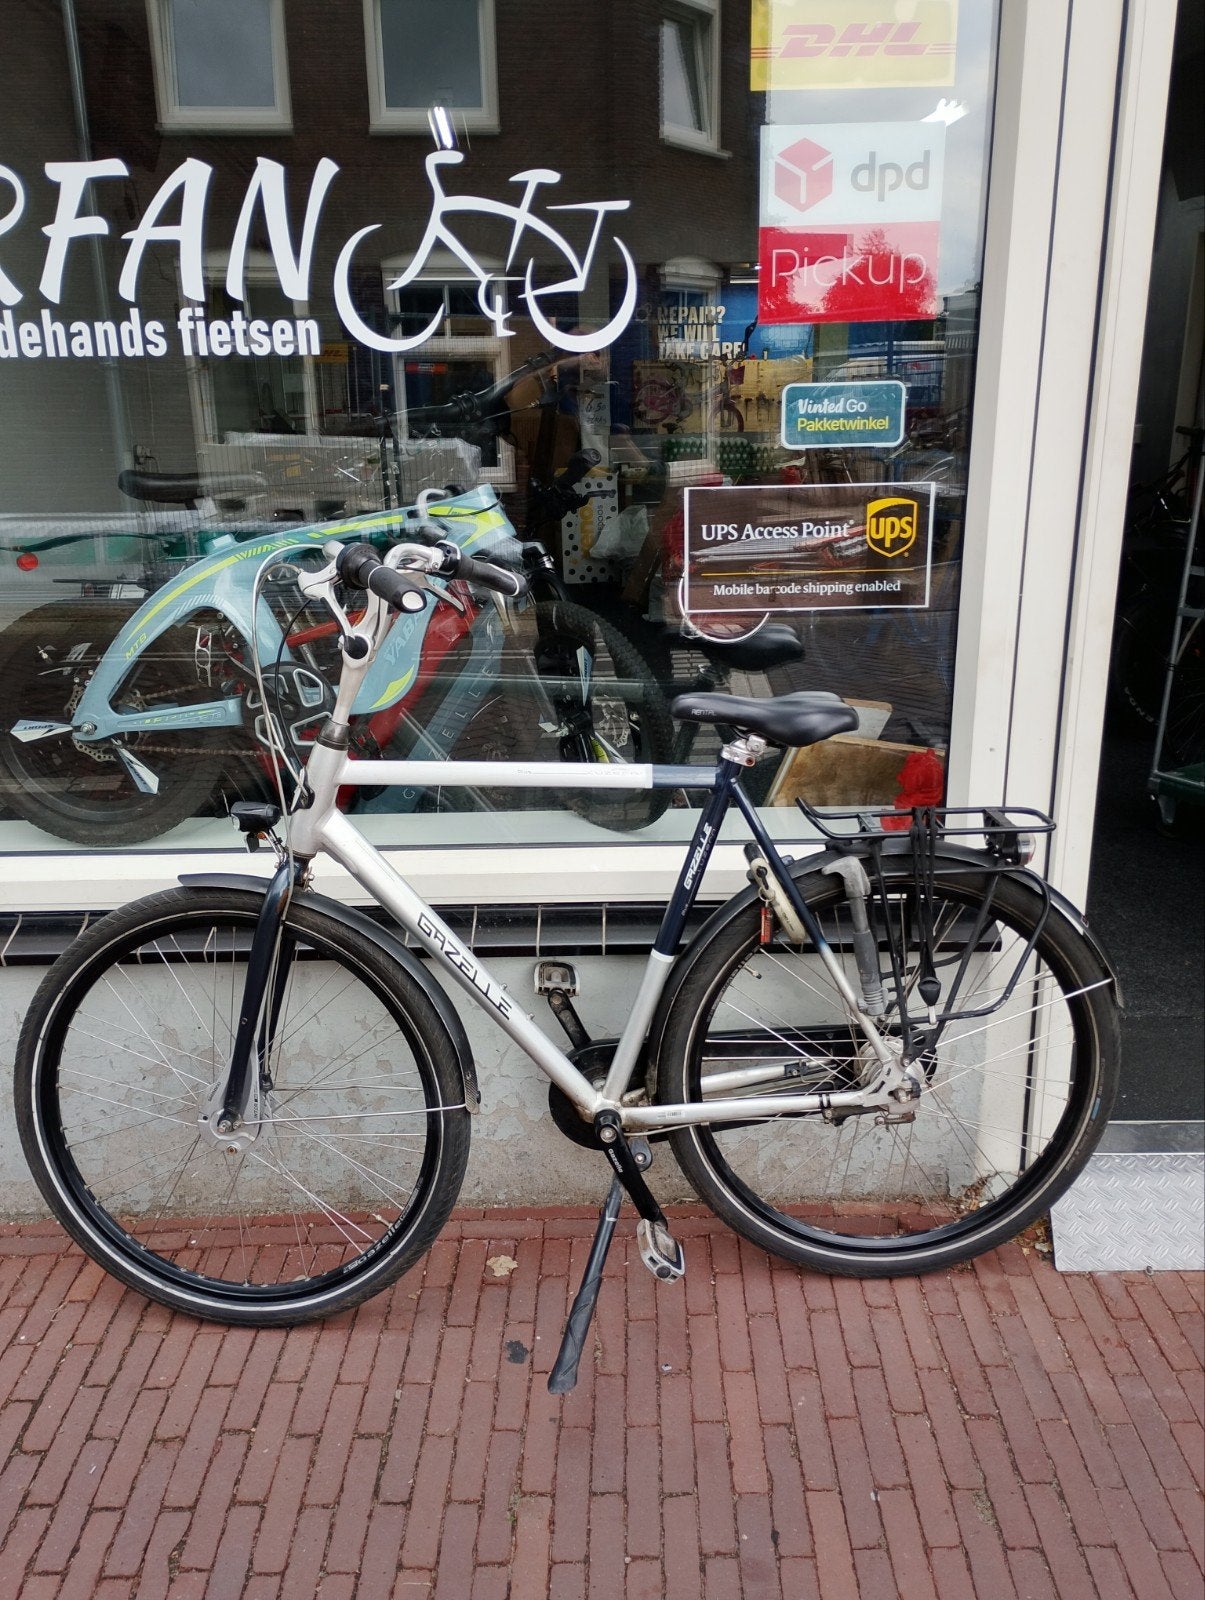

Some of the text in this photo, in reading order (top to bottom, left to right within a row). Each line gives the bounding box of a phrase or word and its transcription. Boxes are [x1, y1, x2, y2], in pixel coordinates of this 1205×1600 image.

[778, 21, 929, 59] DHL
[851, 149, 931, 202] dpd
[770, 245, 927, 294] Pickup
[657, 305, 726, 324] REPAIR?
[0, 307, 320, 358] dehands fietsen
[658, 324, 720, 342] WE WILL
[659, 341, 695, 360] TAKE
[797, 397, 867, 414] Vinted Go
[797, 416, 890, 432] Pakketwinkel
[701, 523, 738, 541] UPS
[742, 523, 798, 540] Access
[870, 516, 913, 548] ups
[713, 583, 754, 596] Mobile
[803, 581, 854, 597] shipping
[855, 580, 901, 594] enabled
[683, 822, 712, 890] GAZELLE
[417, 911, 512, 1021] GAZELLE
